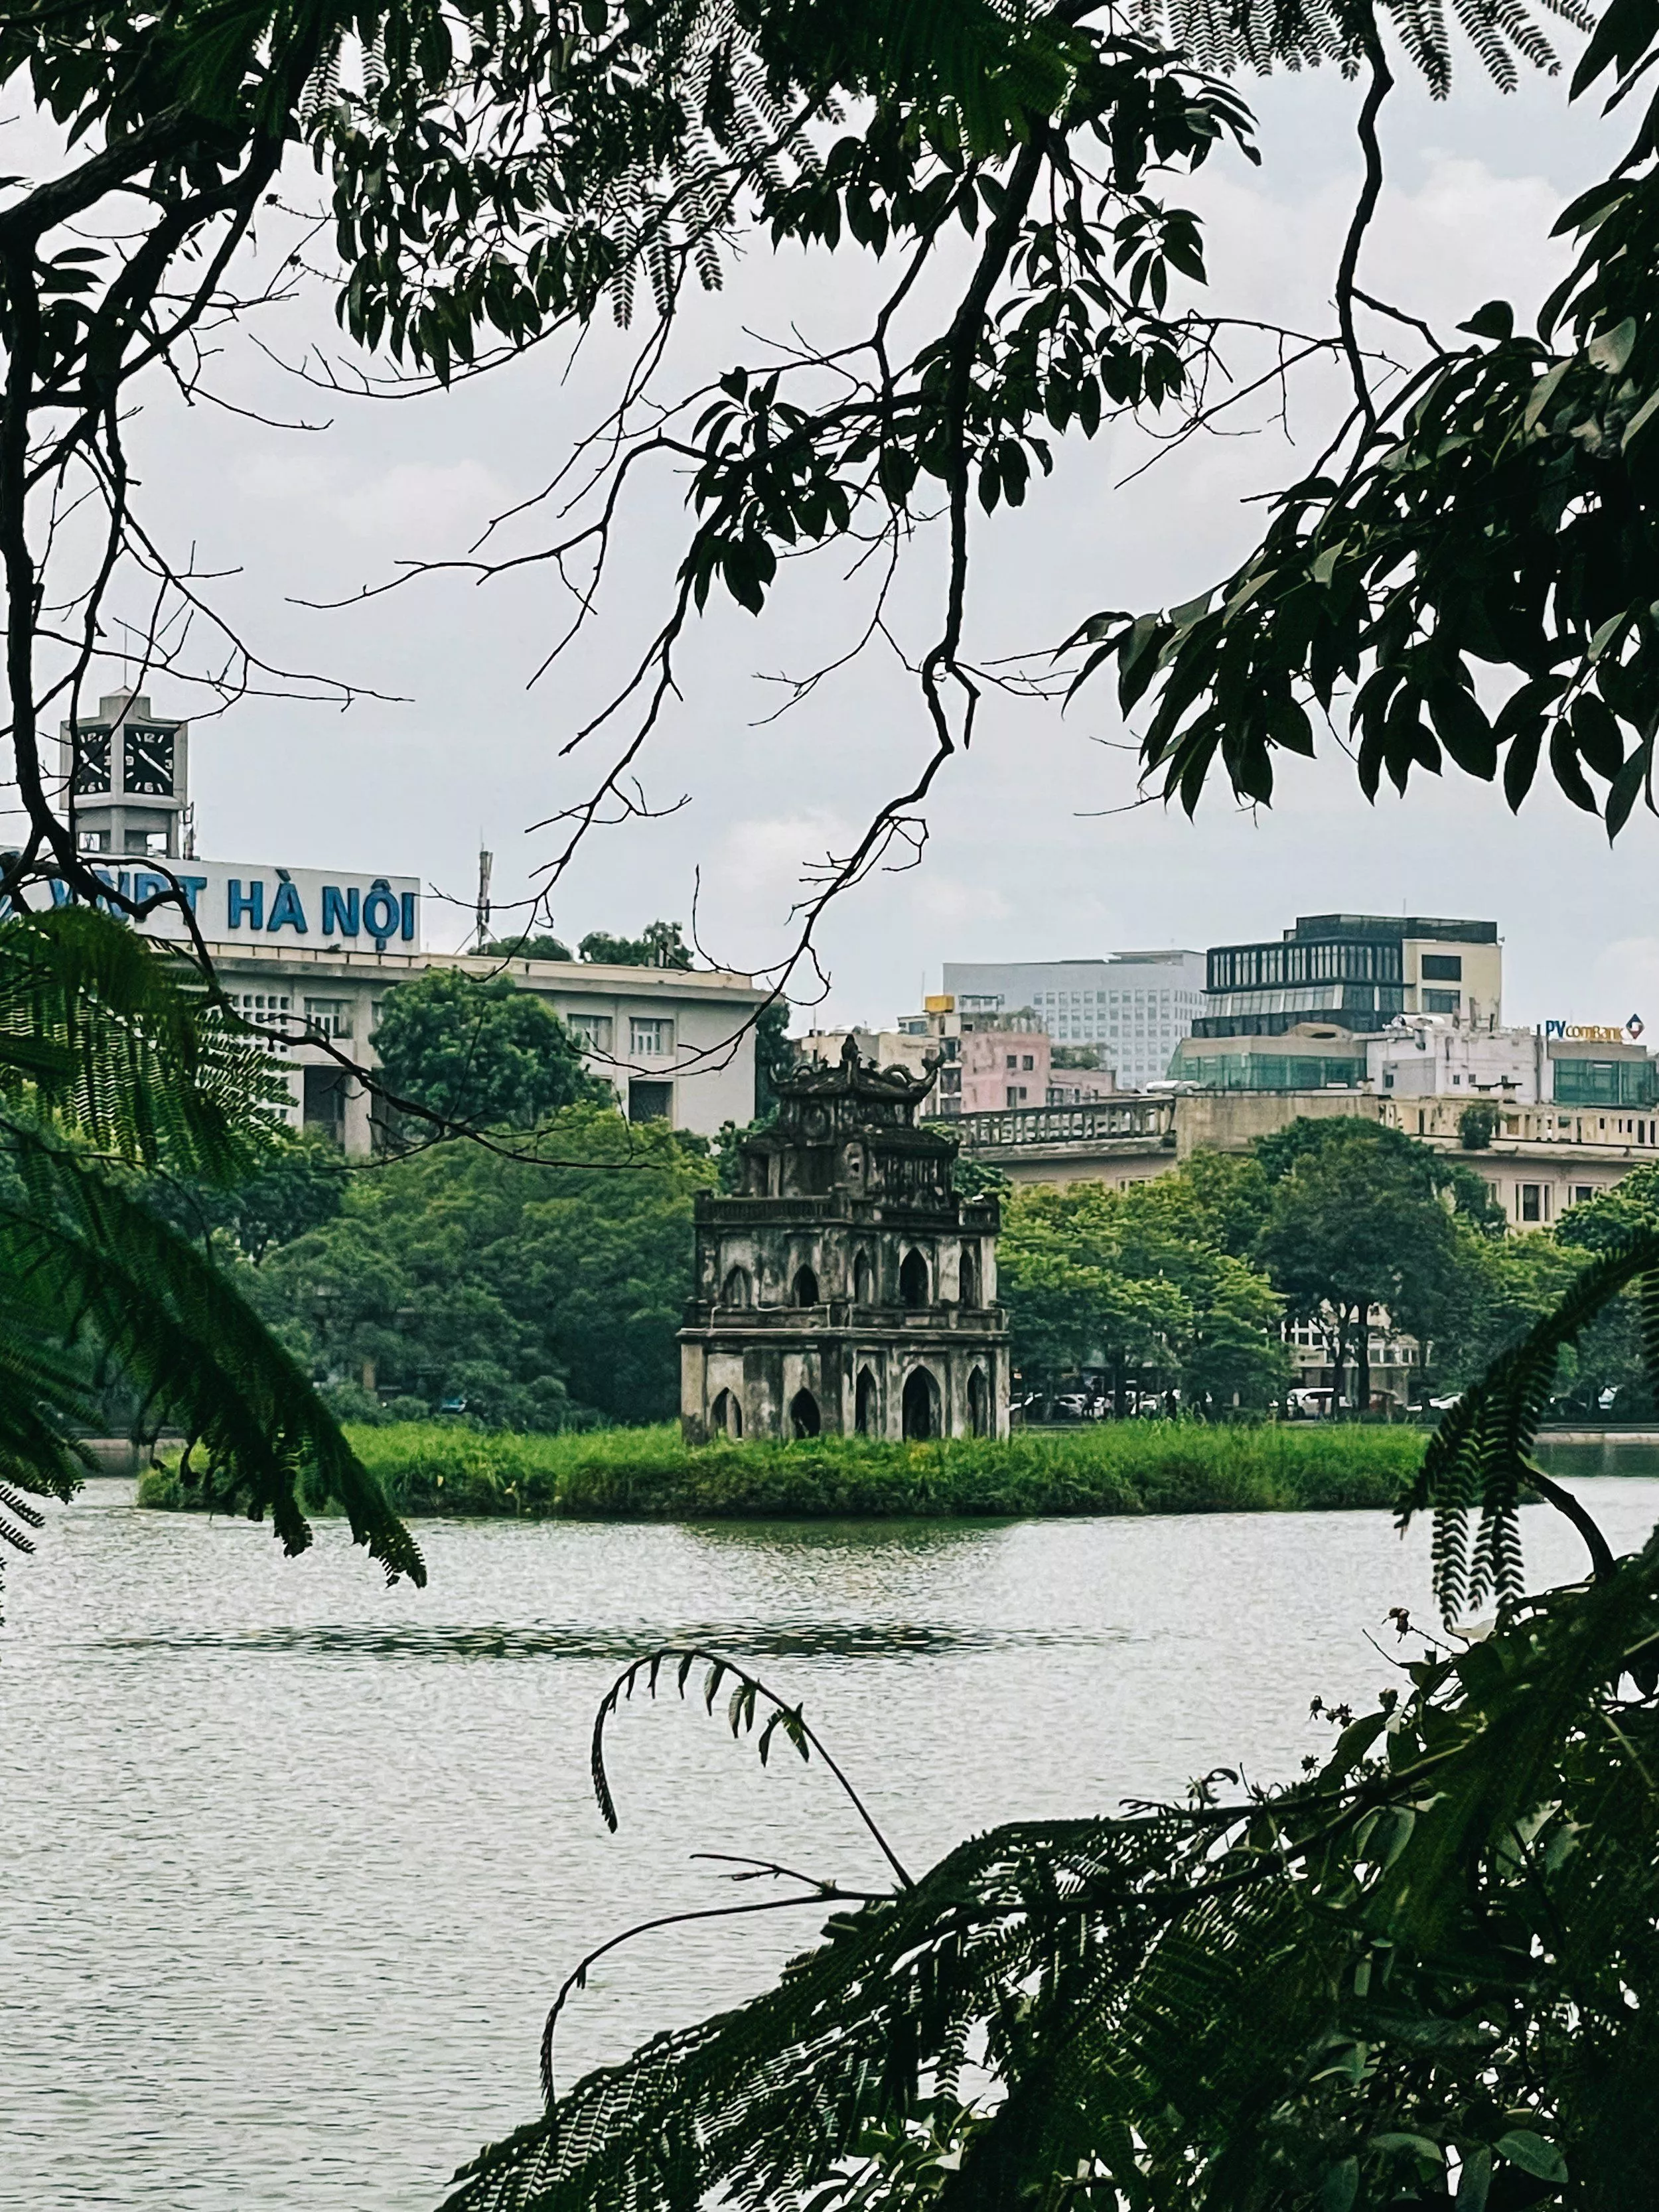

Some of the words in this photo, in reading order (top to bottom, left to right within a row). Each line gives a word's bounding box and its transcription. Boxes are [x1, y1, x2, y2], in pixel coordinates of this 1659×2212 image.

[143, 732, 155, 743] 12
[125, 755, 134, 766] 9
[165, 759, 173, 770] 3
[88, 782, 96, 793] 6
[144, 782, 153, 792] 6
[228, 868, 308, 933] HÀ
[322, 872, 414, 951] NỘI
